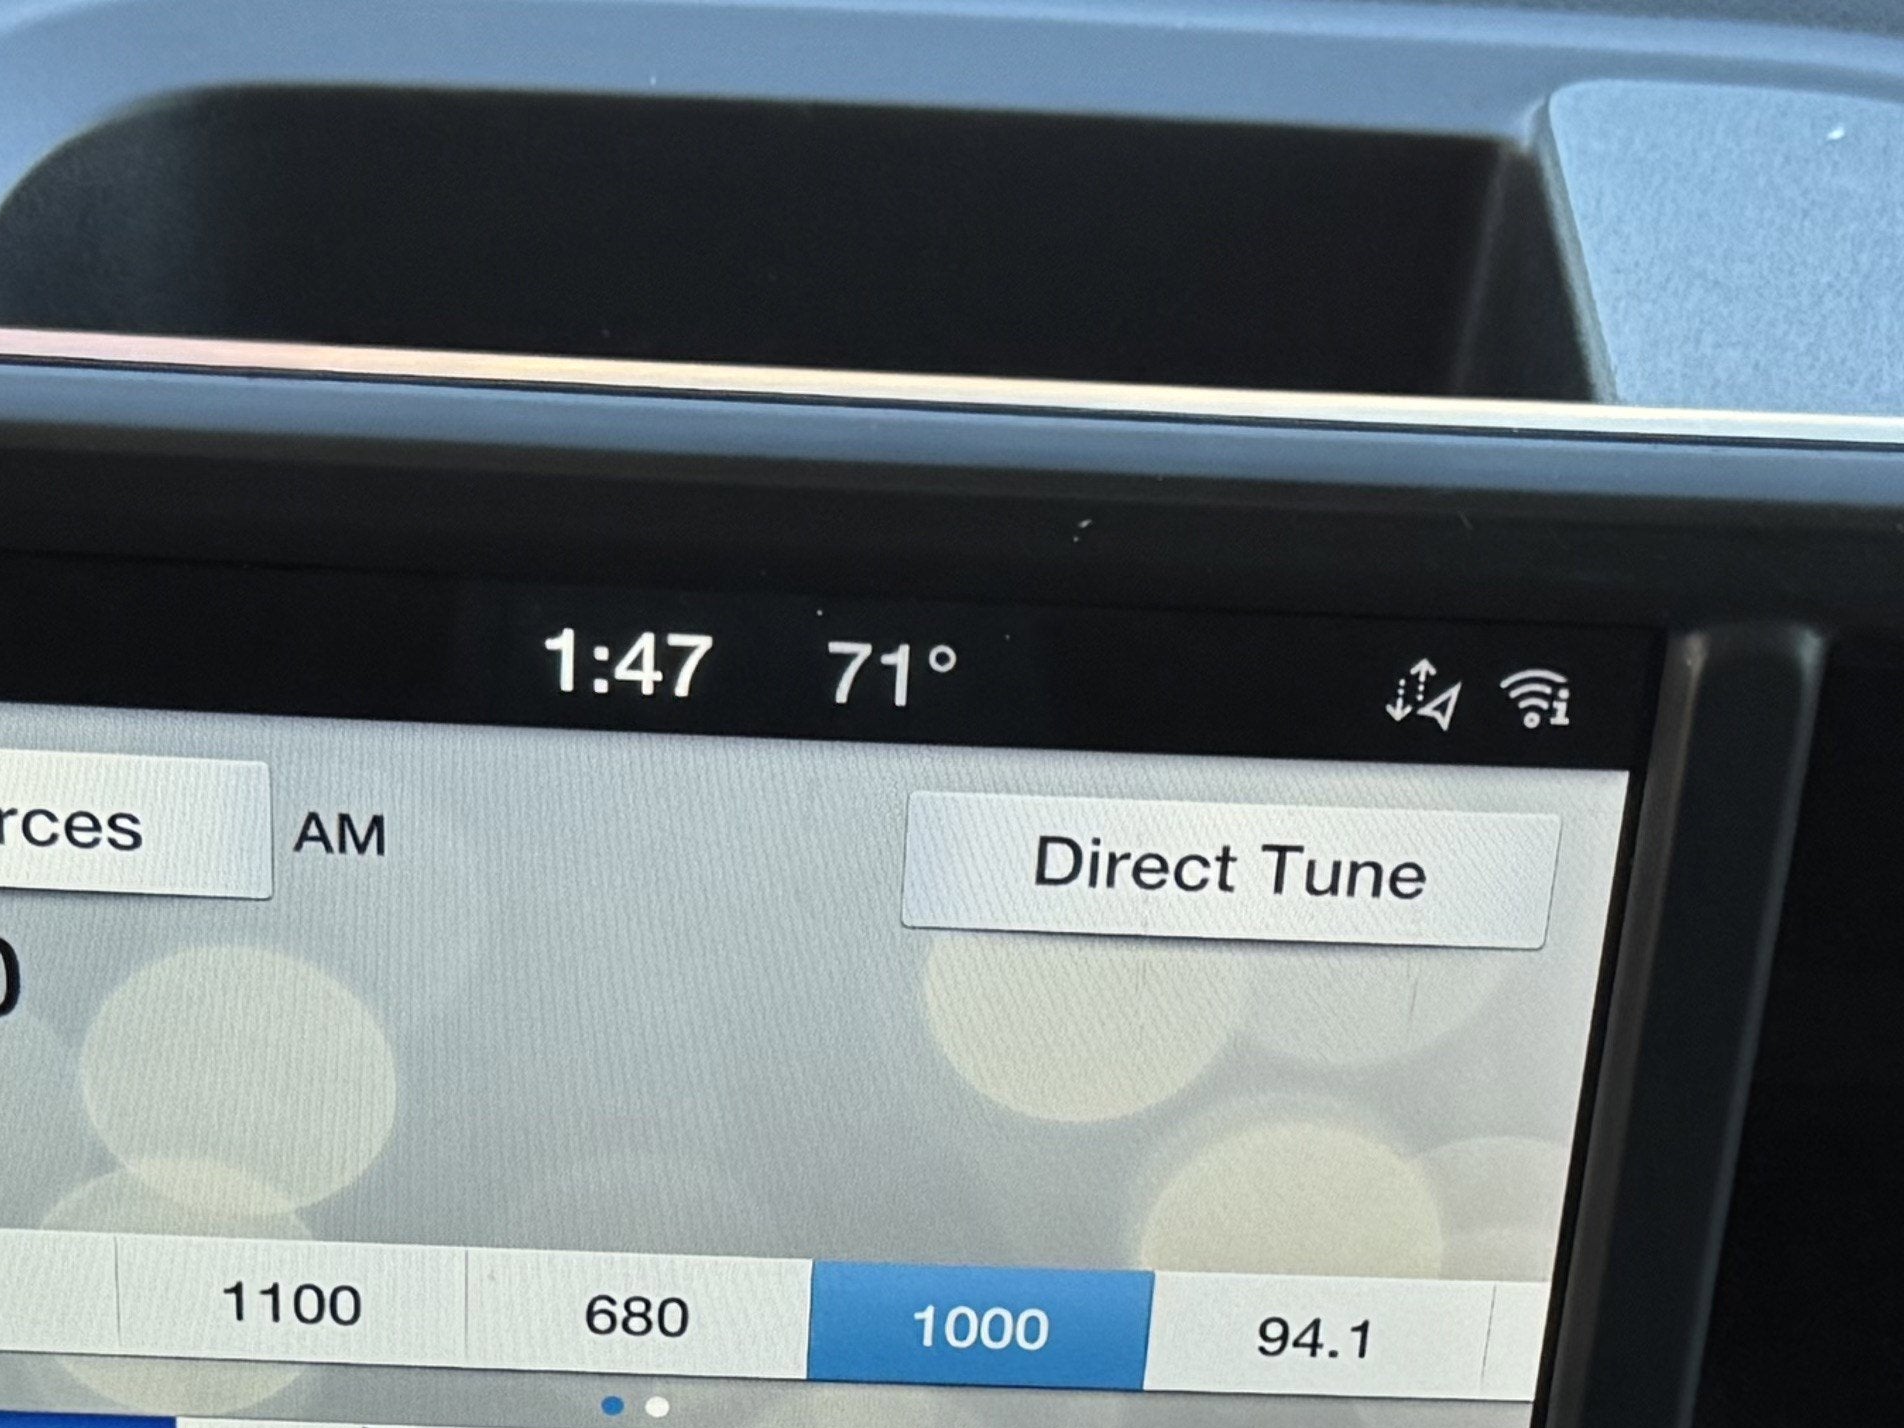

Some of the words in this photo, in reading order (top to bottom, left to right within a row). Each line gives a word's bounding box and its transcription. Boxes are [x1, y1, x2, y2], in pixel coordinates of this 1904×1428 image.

[544, 627, 713, 698] 1:47
[293, 811, 385, 856] AM
[1035, 835, 1238, 893] Direct
[1261, 843, 1427, 900] Tune
[223, 1281, 362, 1327] 1100
[585, 1294, 689, 1338] 680
[913, 1304, 1049, 1351] 1000
[1257, 1316, 1370, 1359] 94.1
